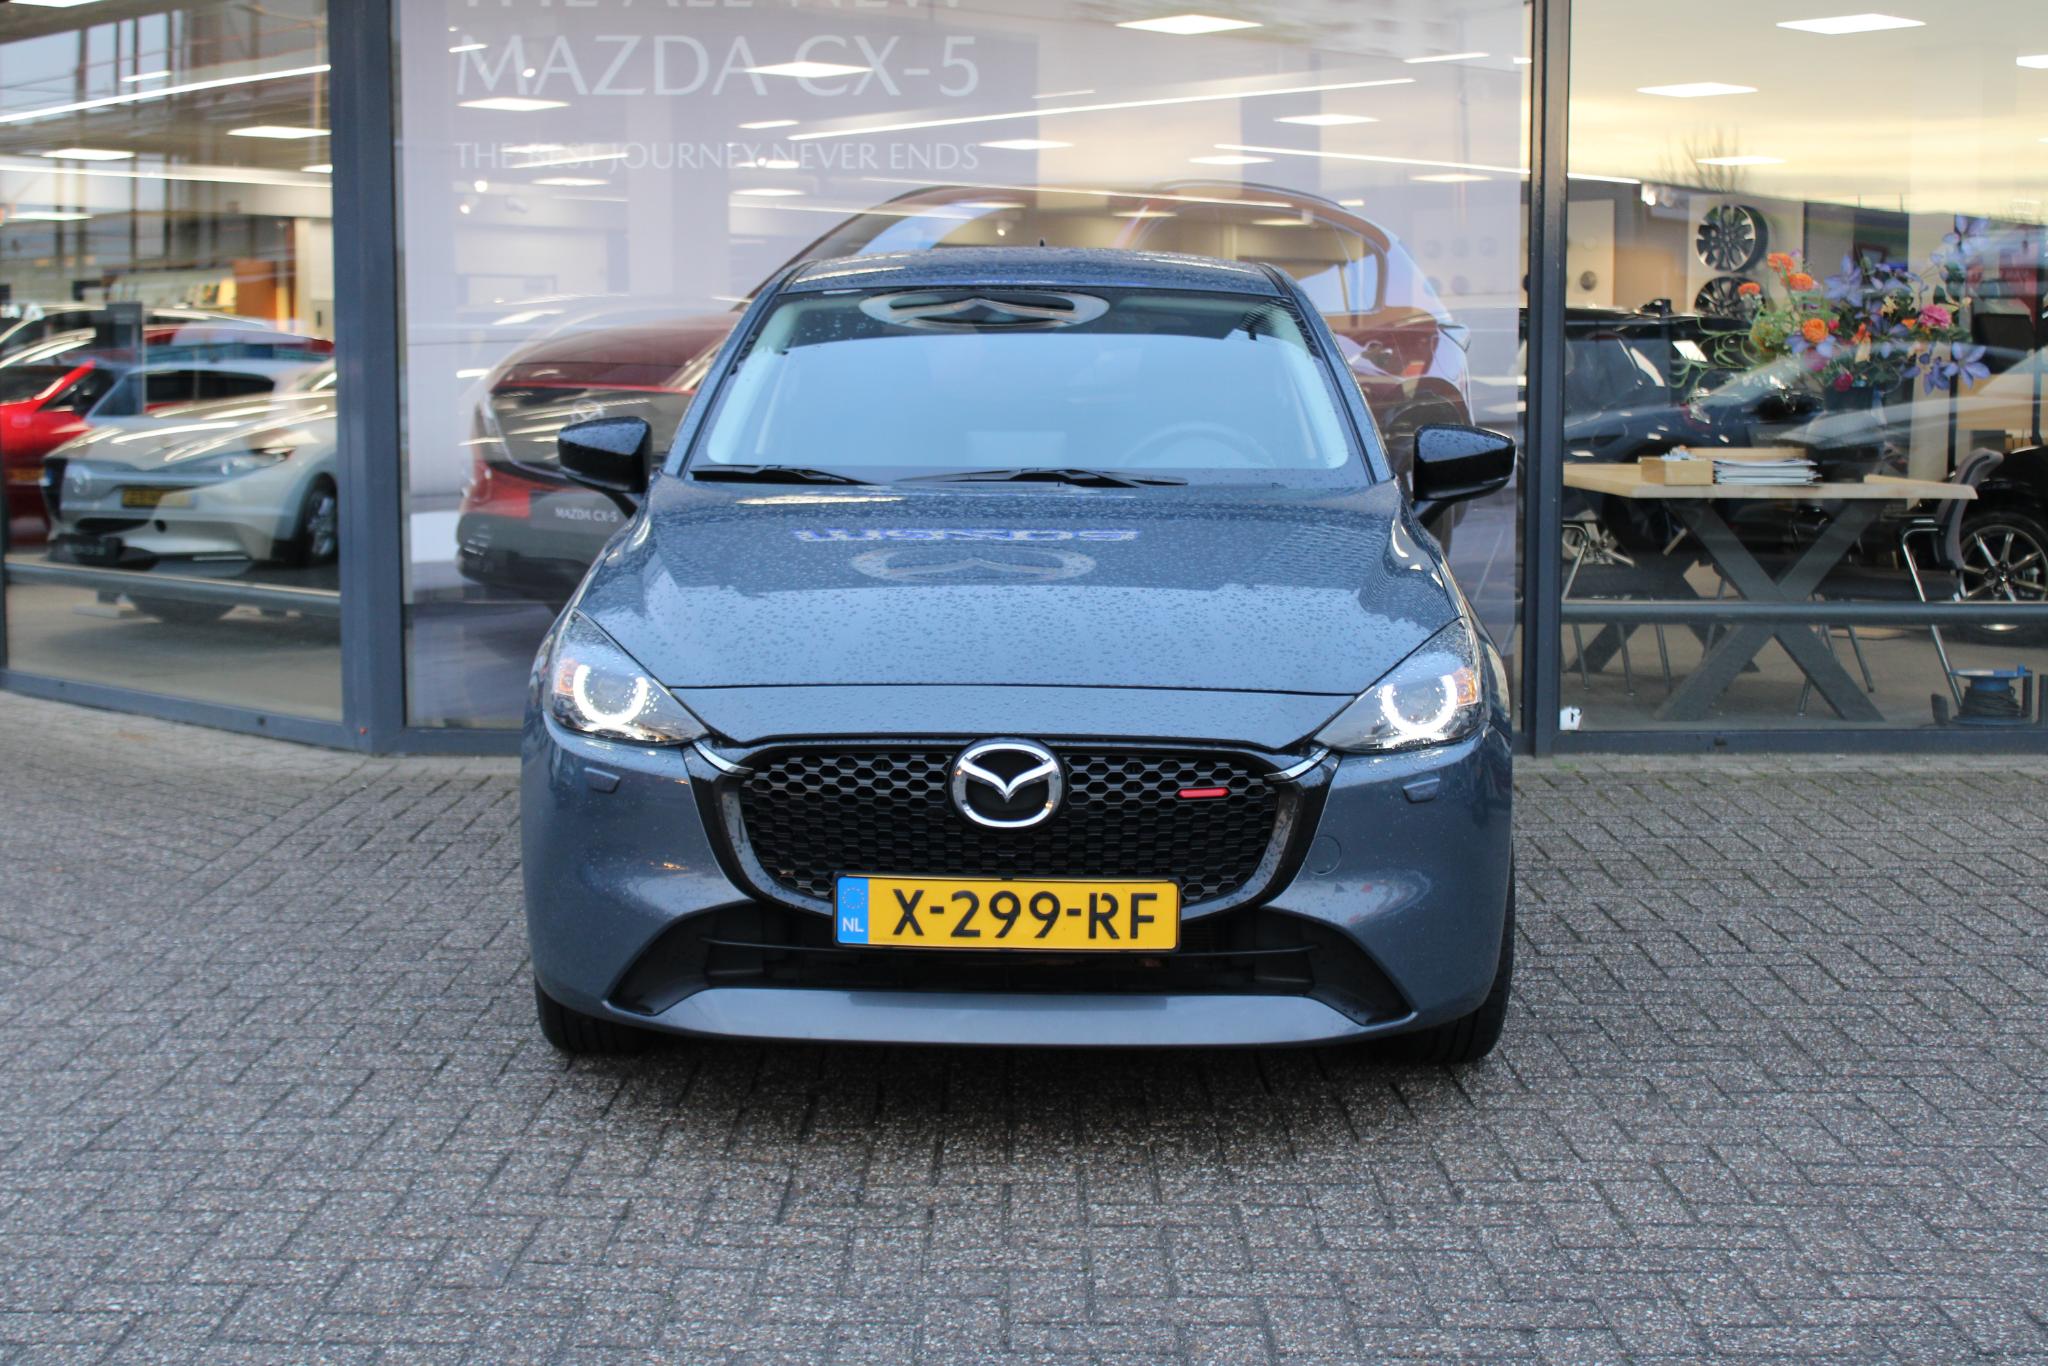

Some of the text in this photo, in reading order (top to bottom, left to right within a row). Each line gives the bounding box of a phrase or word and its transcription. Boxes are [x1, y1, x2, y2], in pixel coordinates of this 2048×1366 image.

[456, 34, 979, 97] MAZDA CX-5
[453, 142, 980, 174] THE BEST JOURNEY NEVER ENDS
[842, 917, 864, 933] NL
[892, 888, 1158, 940] X-299-RF
